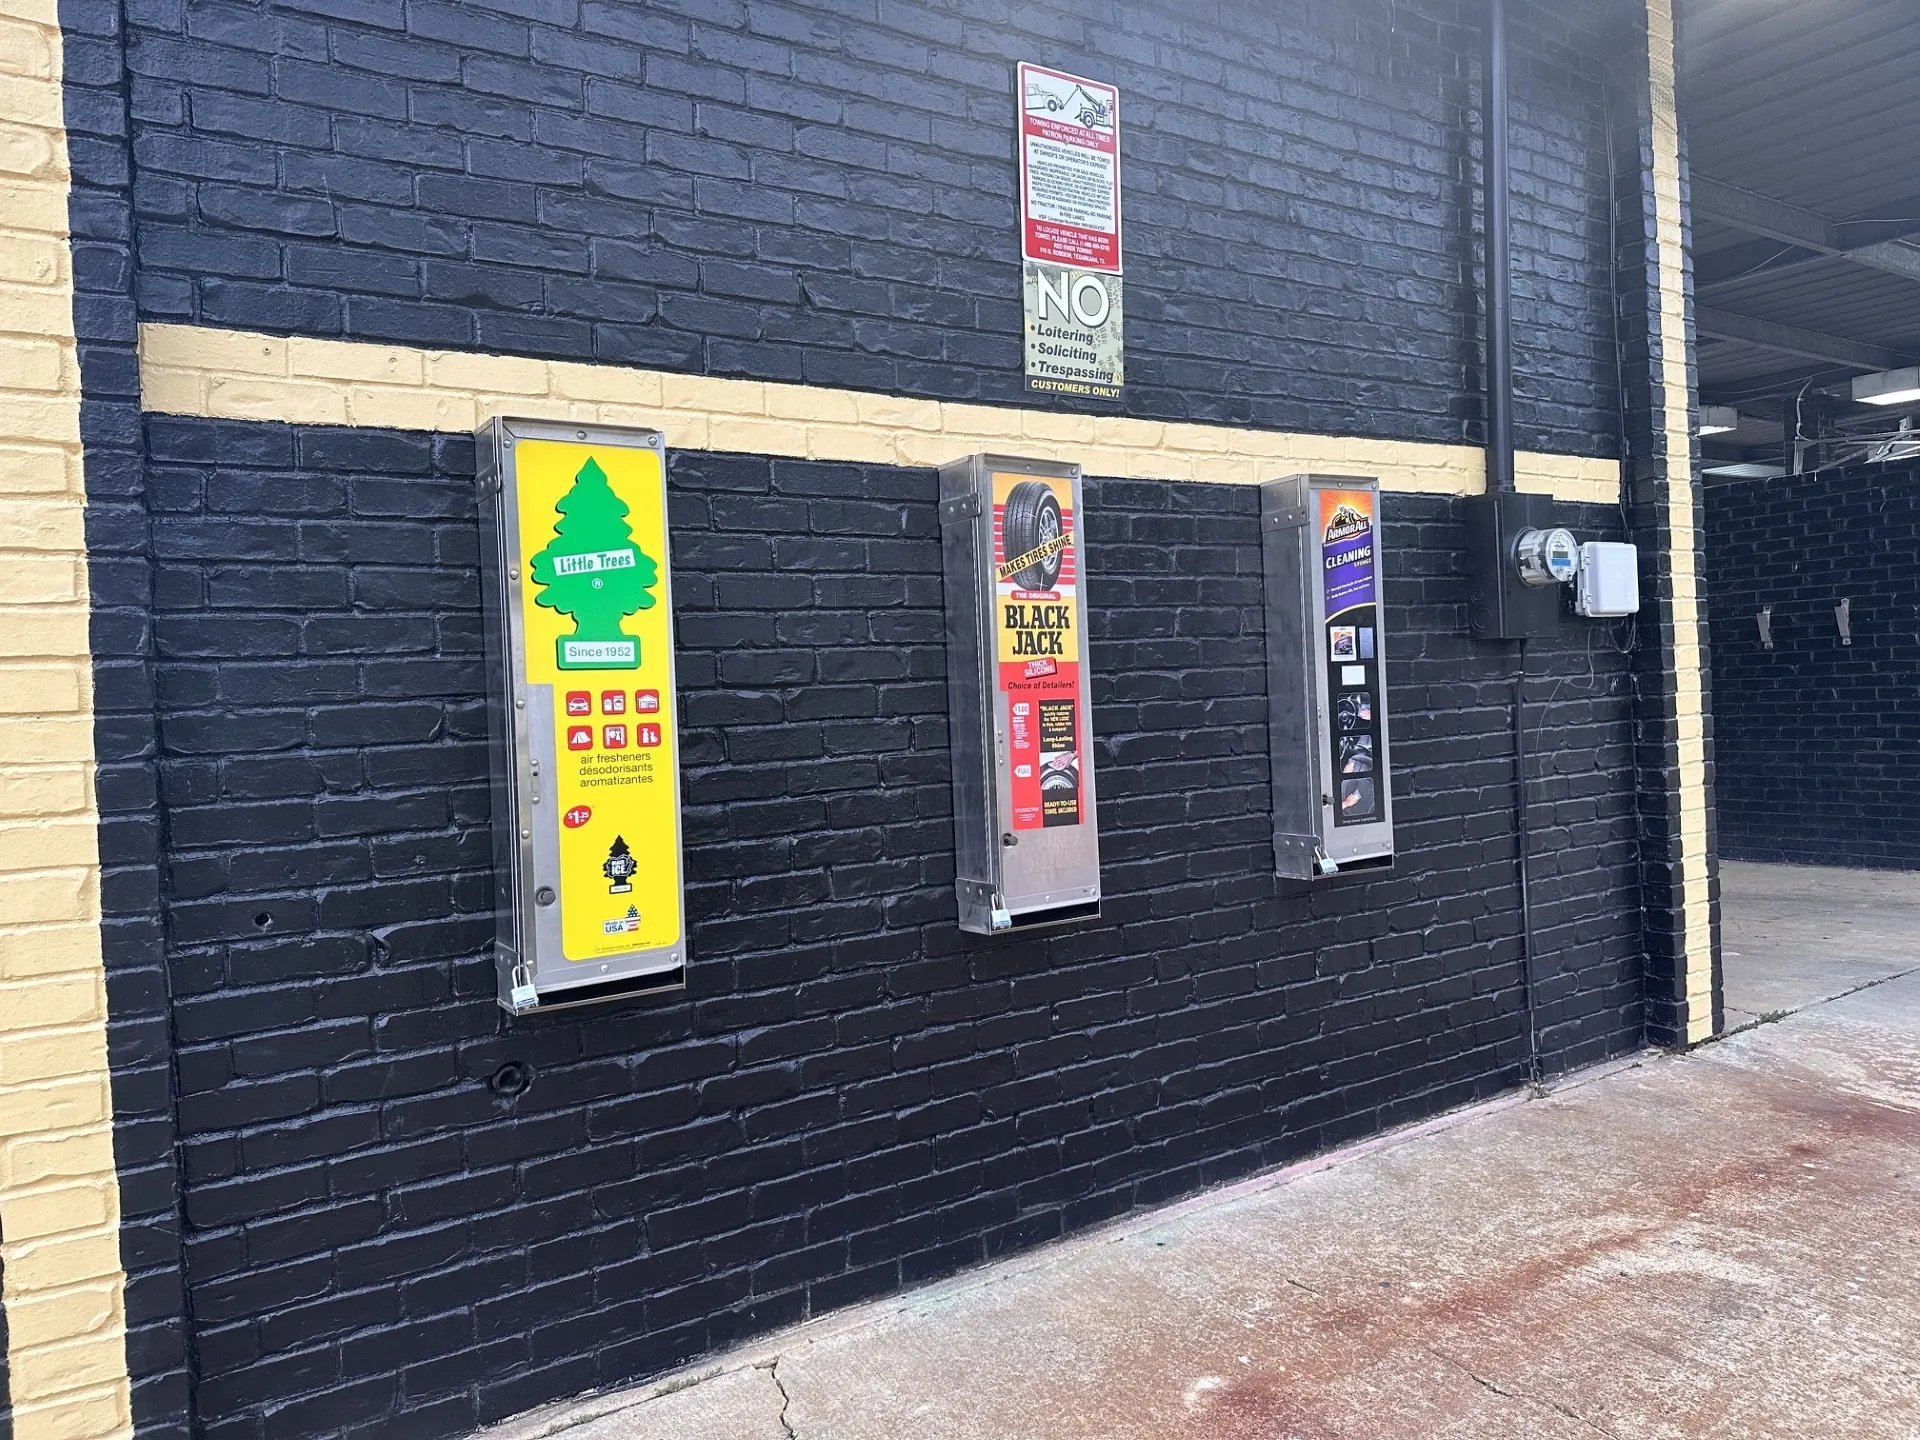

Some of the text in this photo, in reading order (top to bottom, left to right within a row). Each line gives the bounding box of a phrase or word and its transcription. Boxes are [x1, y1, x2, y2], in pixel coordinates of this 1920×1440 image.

[1029, 118, 1050, 128] TOWING
[1051, 123, 1078, 135] ENFORCED
[1086, 131, 1095, 139] ALL
[1096, 134, 1110, 143] TIMES
[1042, 129, 1099, 148] PATRON PARKING ONLY
[1030, 141, 1060, 153] UNAUTHORIZED
[1062, 148, 1080, 157] VEHICLES
[1043, 226, 1059, 234] LOCATE
[1060, 230, 1077, 238] VEHICLE
[1052, 236, 1067, 244] PLEASE
[1038, 267, 1110, 328] NO
[1037, 324, 1093, 345] Loitering
[1038, 343, 1097, 364] Soliciting
[1039, 360, 1114, 384] Trespassing
[1031, 380, 1120, 398] CUSTOMERS ONLY!
[560, 554, 631, 573] Little Trees
[1000, 535, 1072, 578] MAKES TIRES SHINE
[1326, 546, 1371, 569] CLEANING
[1354, 558, 1372, 568] SPONGE
[1005, 605, 1070, 629] BLACK
[1012, 631, 1063, 655] JACK
[569, 646, 631, 657] Since 1952
[1024, 666, 1055, 677] SILICONE
[1028, 659, 1048, 668] THICK
[1042, 680, 1075, 689] Detailers!
[581, 753, 651, 764] air fresheners
[580, 764, 653, 776] désodorisants
[580, 775, 653, 787] aromatizantes
[612, 864, 626, 875] ICE
[606, 924, 623, 933] USA
